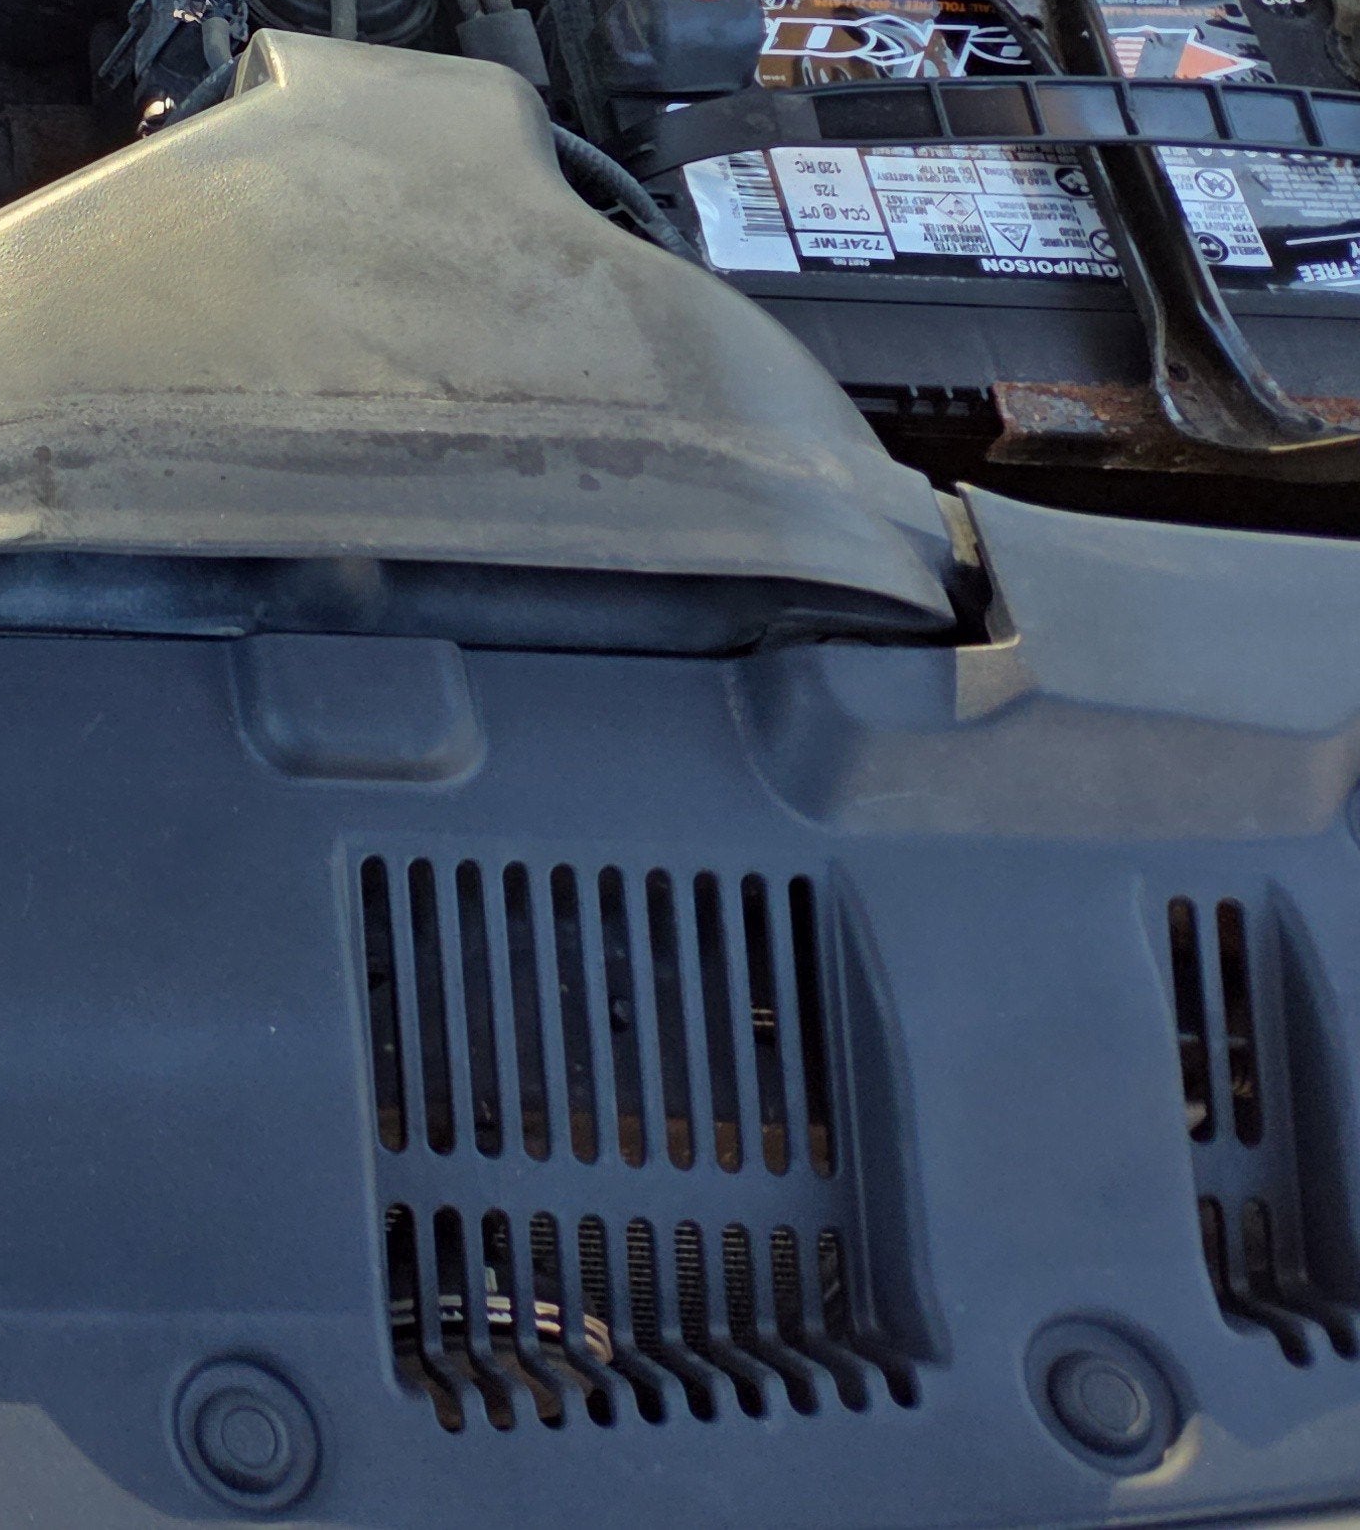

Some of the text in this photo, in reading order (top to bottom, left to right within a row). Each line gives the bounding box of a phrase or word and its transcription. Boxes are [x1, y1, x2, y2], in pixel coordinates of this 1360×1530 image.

[937, 0, 966, 12] TOLL
[795, 160, 842, 174] 120 RC
[814, 185, 839, 197] 725
[822, 204, 837, 220] @
[840, 207, 871, 222] CCA
[808, 236, 884, 251] 724FMF
[980, 258, 1121, 278] GER/POISON
